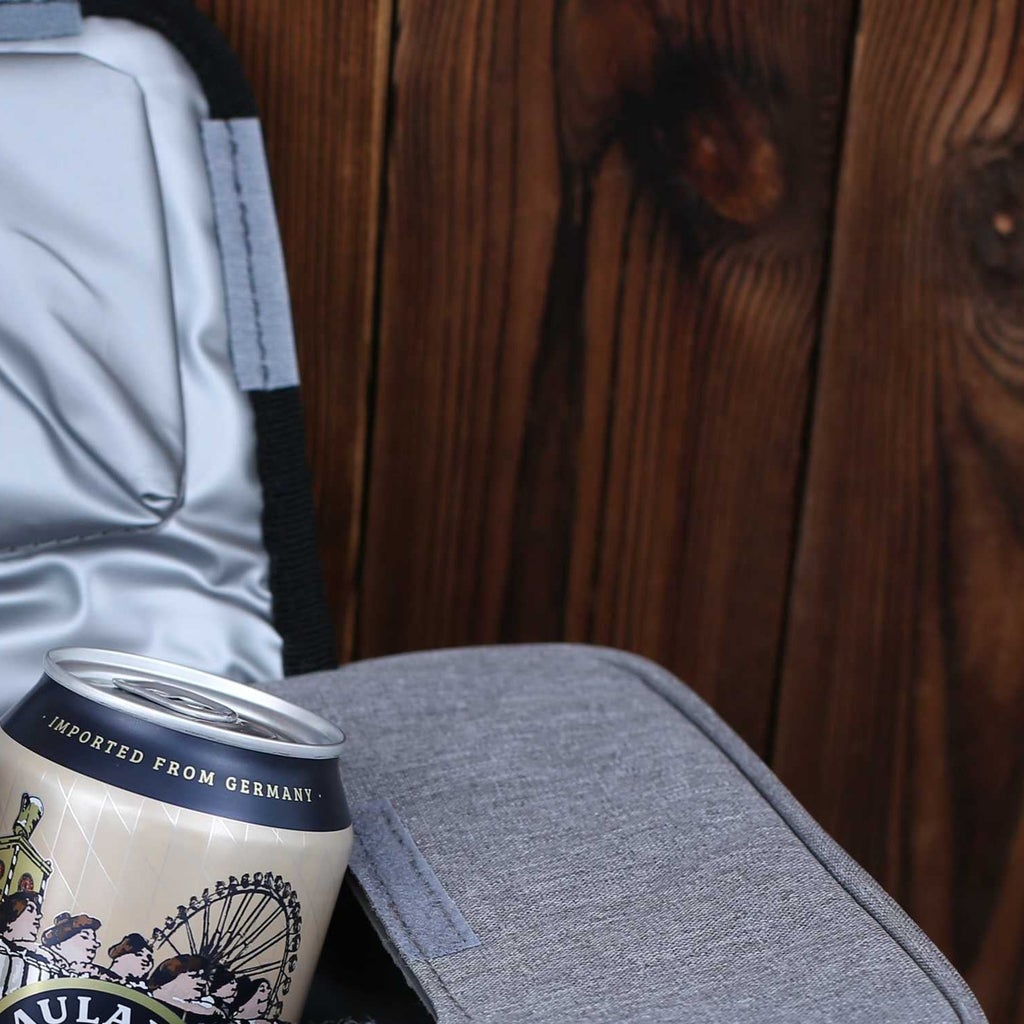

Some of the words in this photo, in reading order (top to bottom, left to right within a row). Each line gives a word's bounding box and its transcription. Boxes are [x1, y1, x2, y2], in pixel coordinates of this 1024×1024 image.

[48, 715, 145, 765] IMPORTED
[152, 756, 215, 787] FROM
[225, 775, 314, 803] GERMANY
